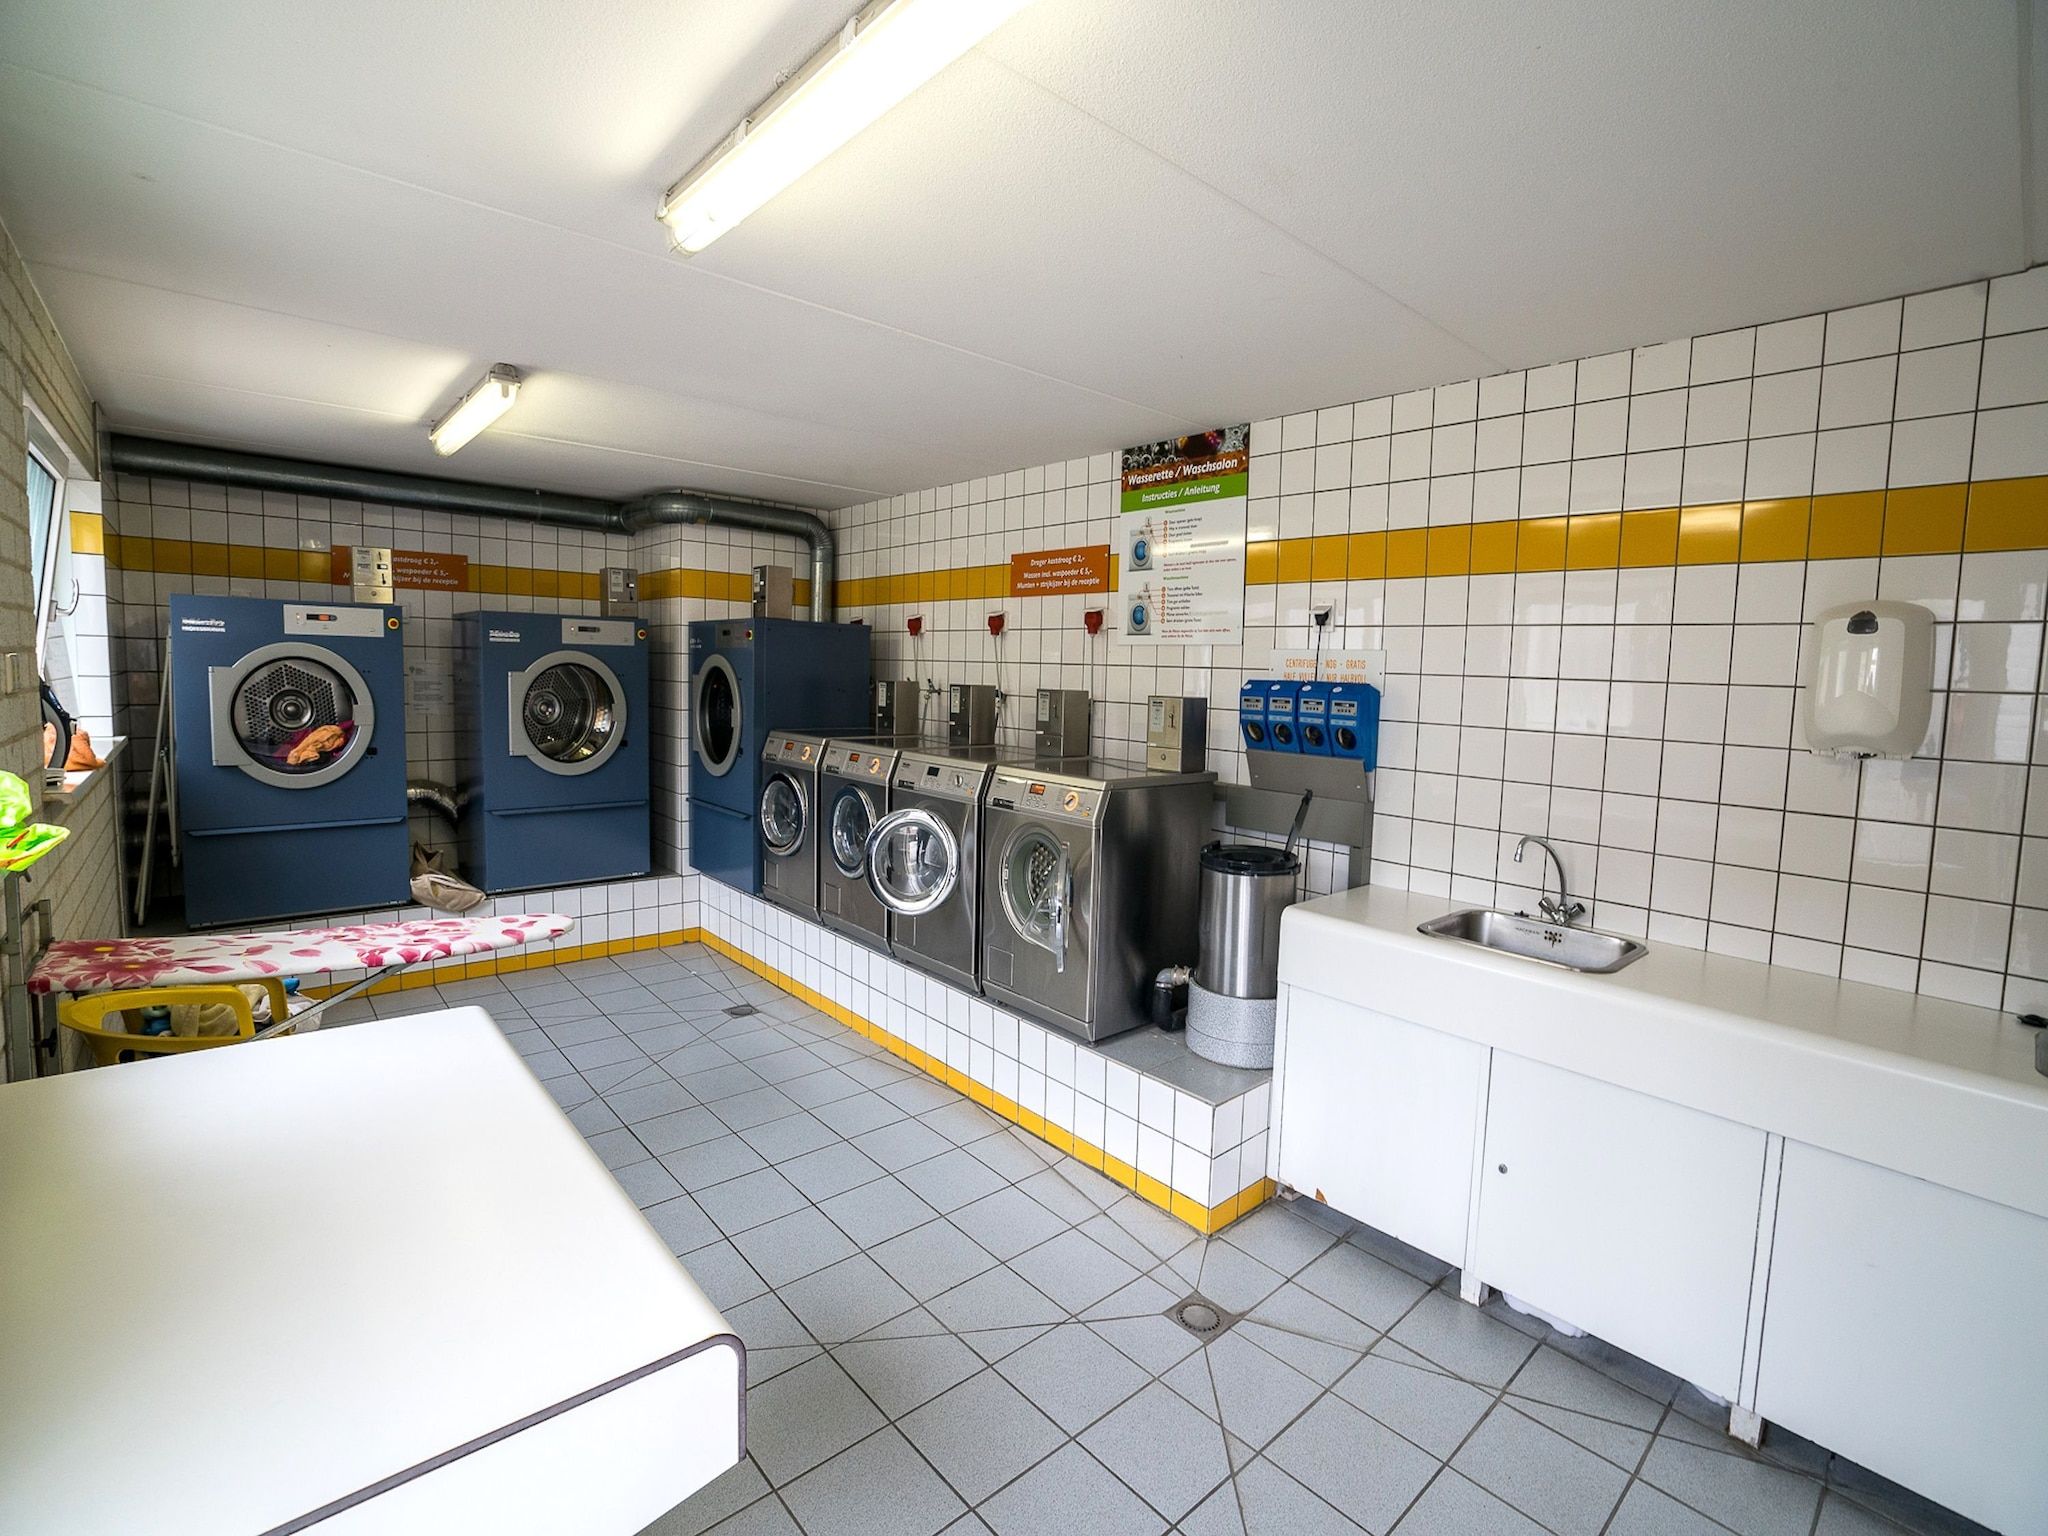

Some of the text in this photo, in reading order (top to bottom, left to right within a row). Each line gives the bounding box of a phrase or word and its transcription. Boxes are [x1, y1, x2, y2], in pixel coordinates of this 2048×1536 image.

[1127, 458, 1238, 486] Wasserette / Waschsalon
[1141, 483, 1220, 503] Instructies / Anleitung
